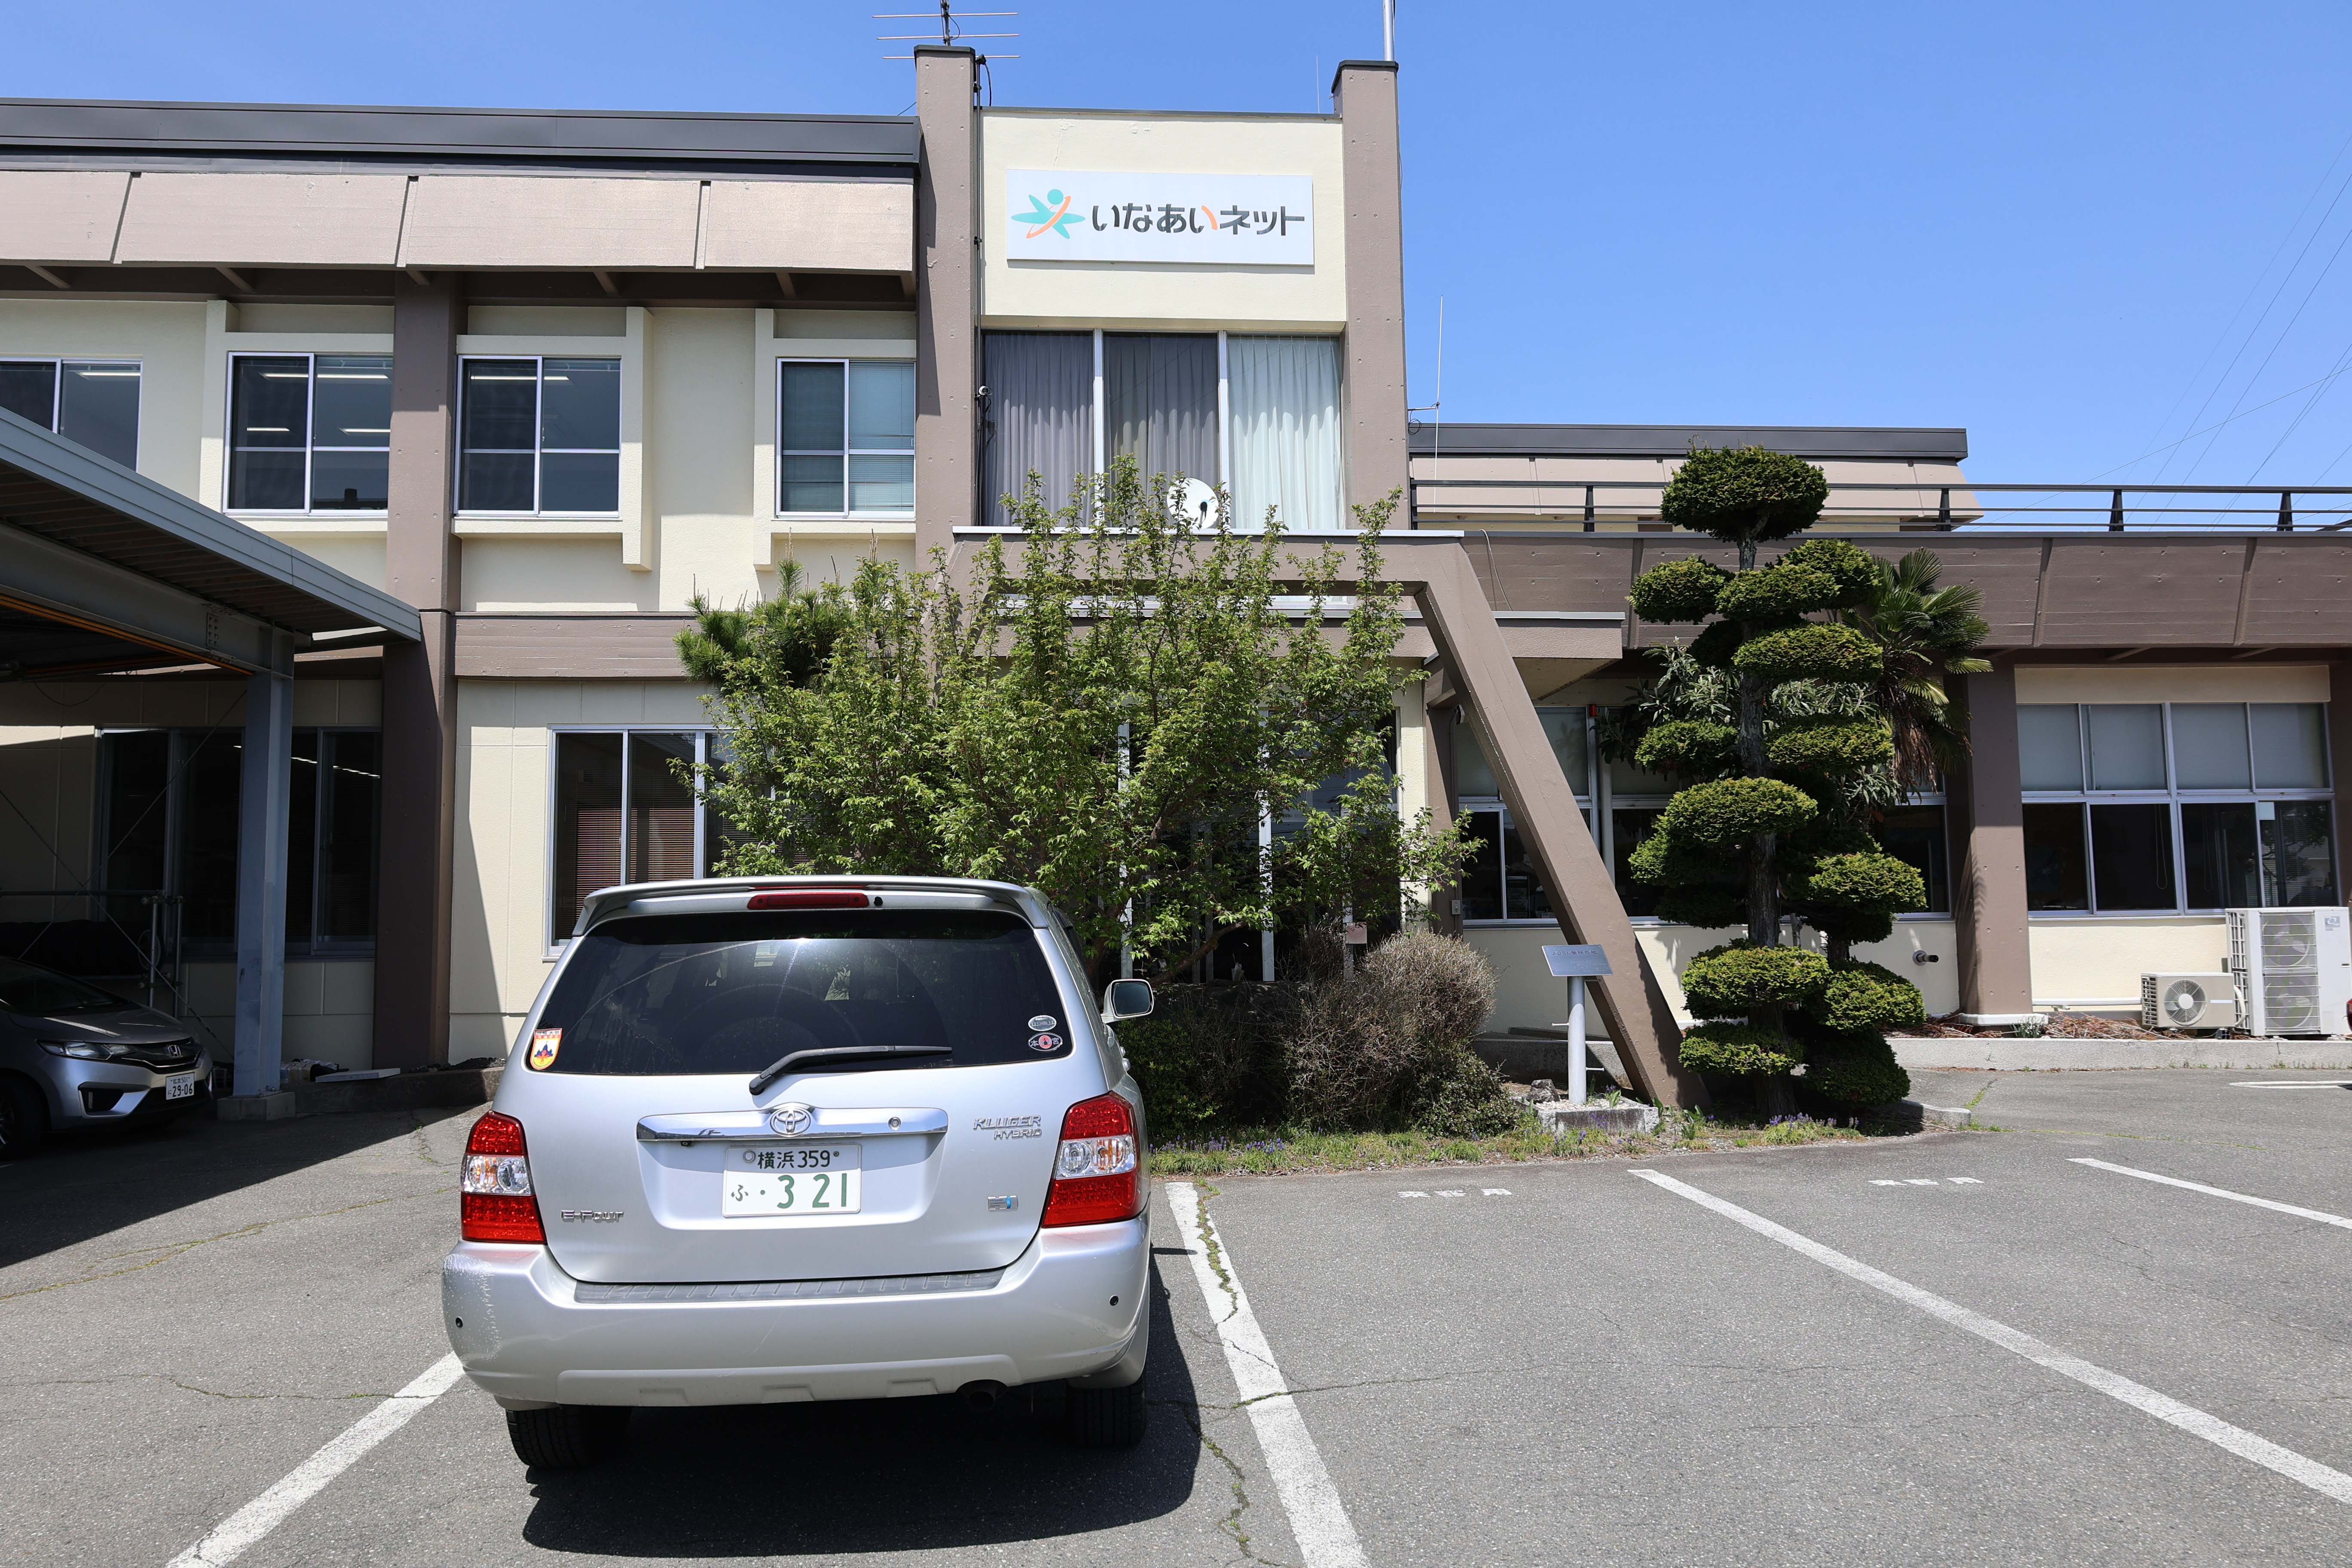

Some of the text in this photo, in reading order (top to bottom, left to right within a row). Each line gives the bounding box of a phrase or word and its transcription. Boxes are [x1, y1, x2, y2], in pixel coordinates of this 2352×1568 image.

[1092, 202, 1305, 236] いなあいネット
[973, 1115, 1041, 1130] KLUGER
[994, 1129, 1042, 1139] HYBRID
[757, 1150, 830, 1170] 横浜359
[731, 1185, 749, 1202] ふ
